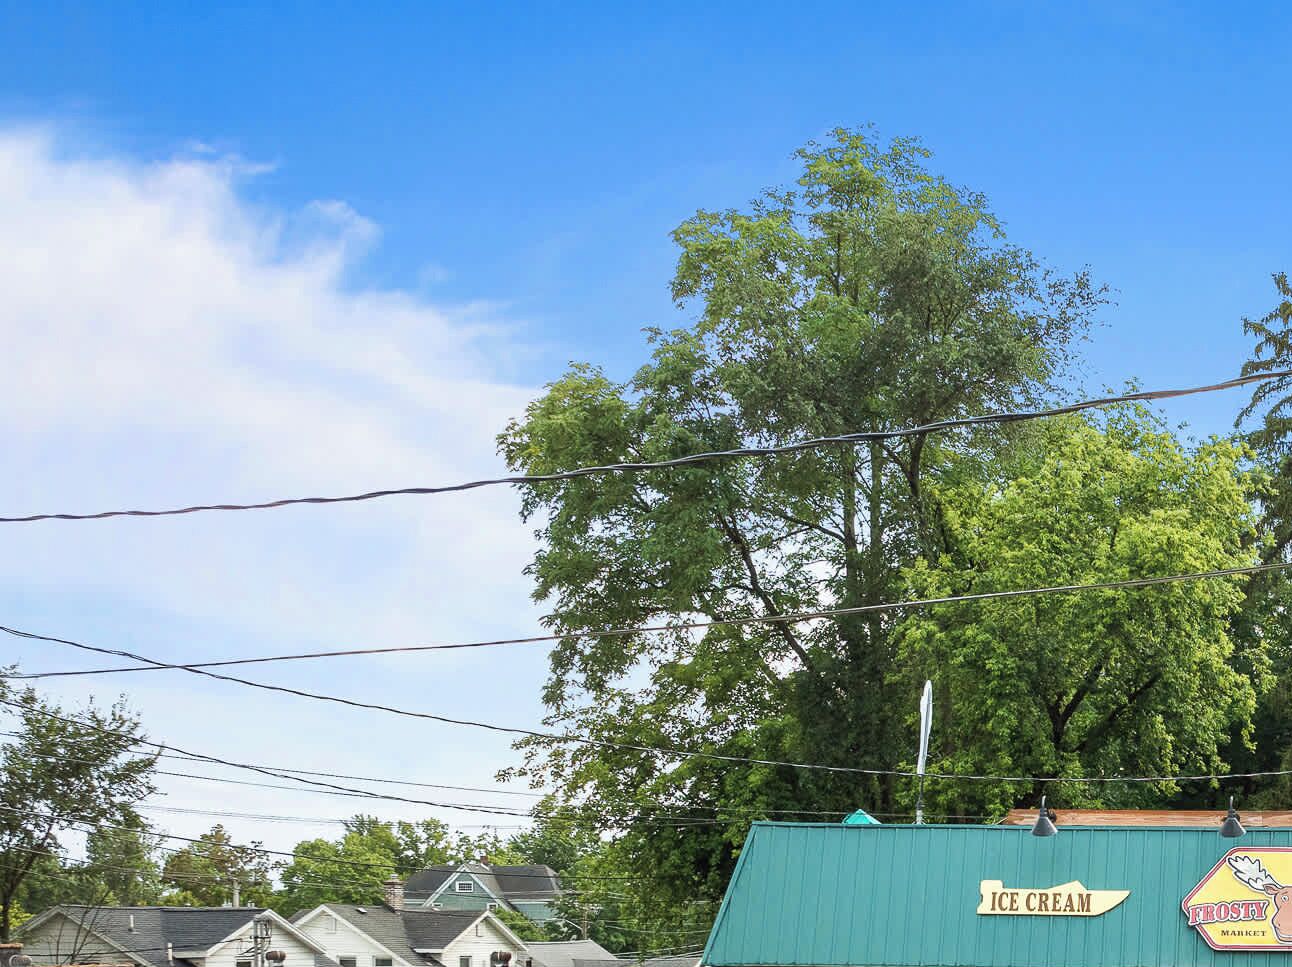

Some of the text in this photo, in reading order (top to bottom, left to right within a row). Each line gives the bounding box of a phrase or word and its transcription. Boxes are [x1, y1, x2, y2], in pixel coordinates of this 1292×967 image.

[990, 891, 1093, 913] ICE CREAM
[1189, 900, 1268, 925] FROSTY
